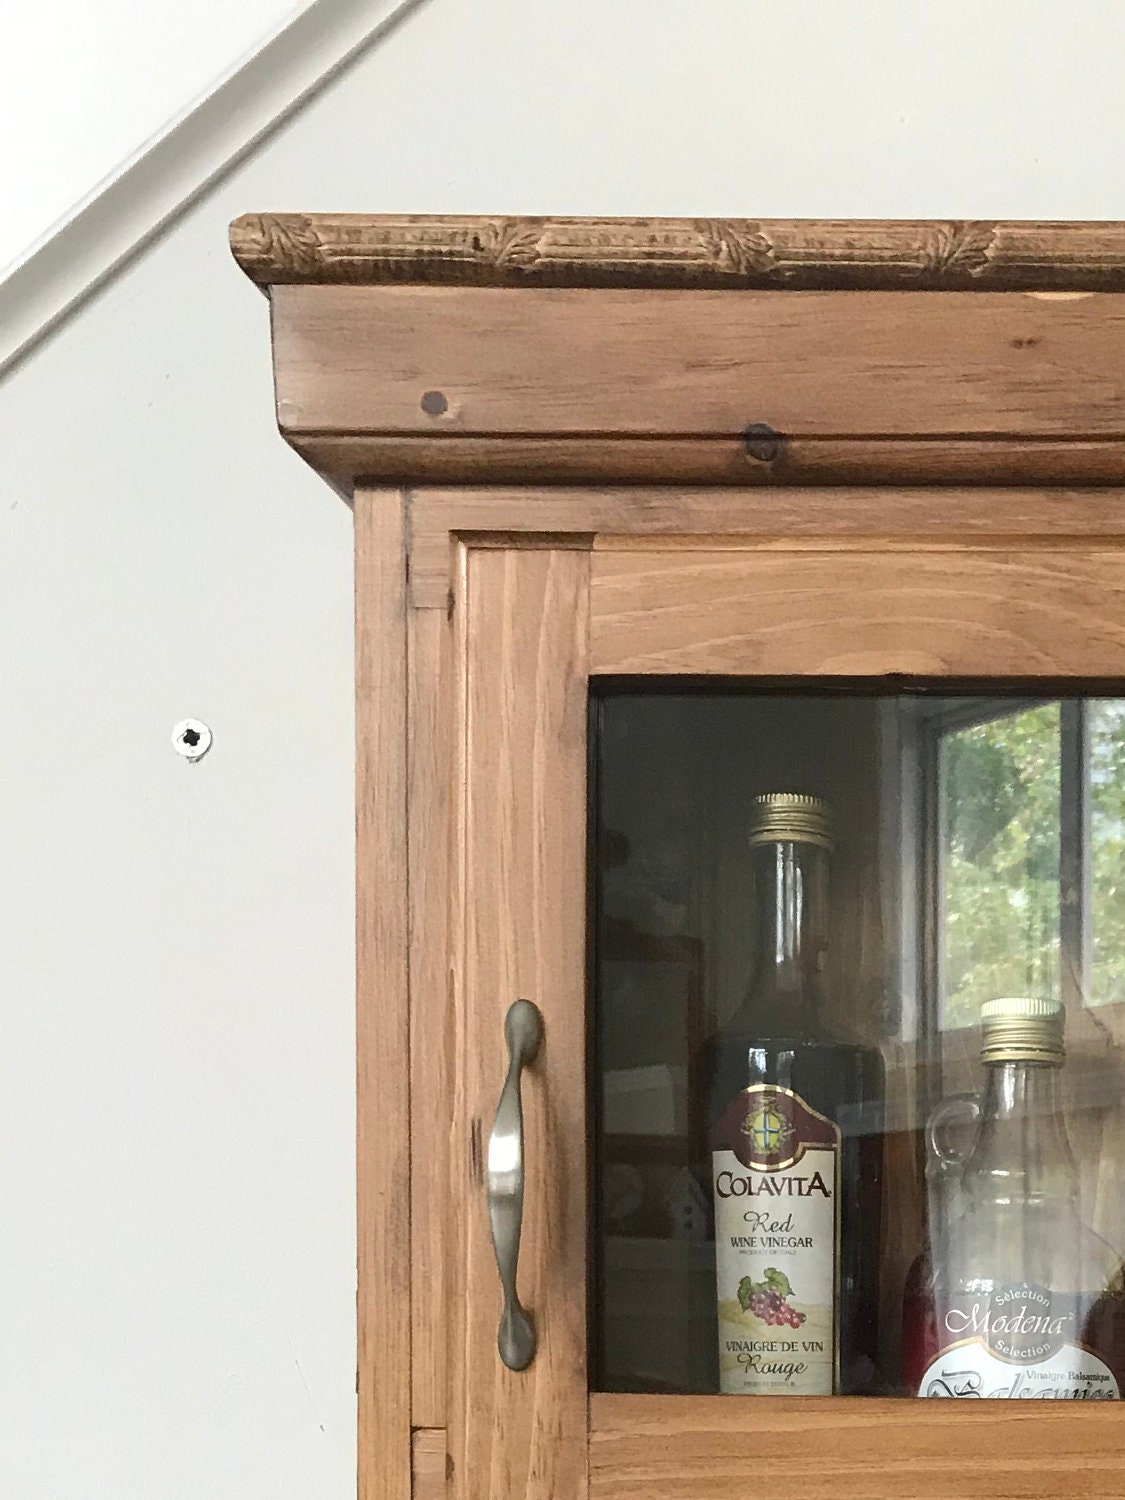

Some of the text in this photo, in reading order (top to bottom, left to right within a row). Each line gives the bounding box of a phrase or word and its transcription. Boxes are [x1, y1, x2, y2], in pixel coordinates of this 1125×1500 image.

[716, 1170, 831, 1199] COLAVITA
[743, 1210, 794, 1233] Red
[730, 1237, 813, 1248] WINE VINEGAR
[944, 1303, 1067, 1335] Modena
[726, 1341, 824, 1352] VINAIGRE DE VIN
[994, 1340, 1051, 1359] Selection
[736, 1352, 808, 1381] Rouge
[1026, 1370, 1110, 1383] Vinaigre Balsamique
